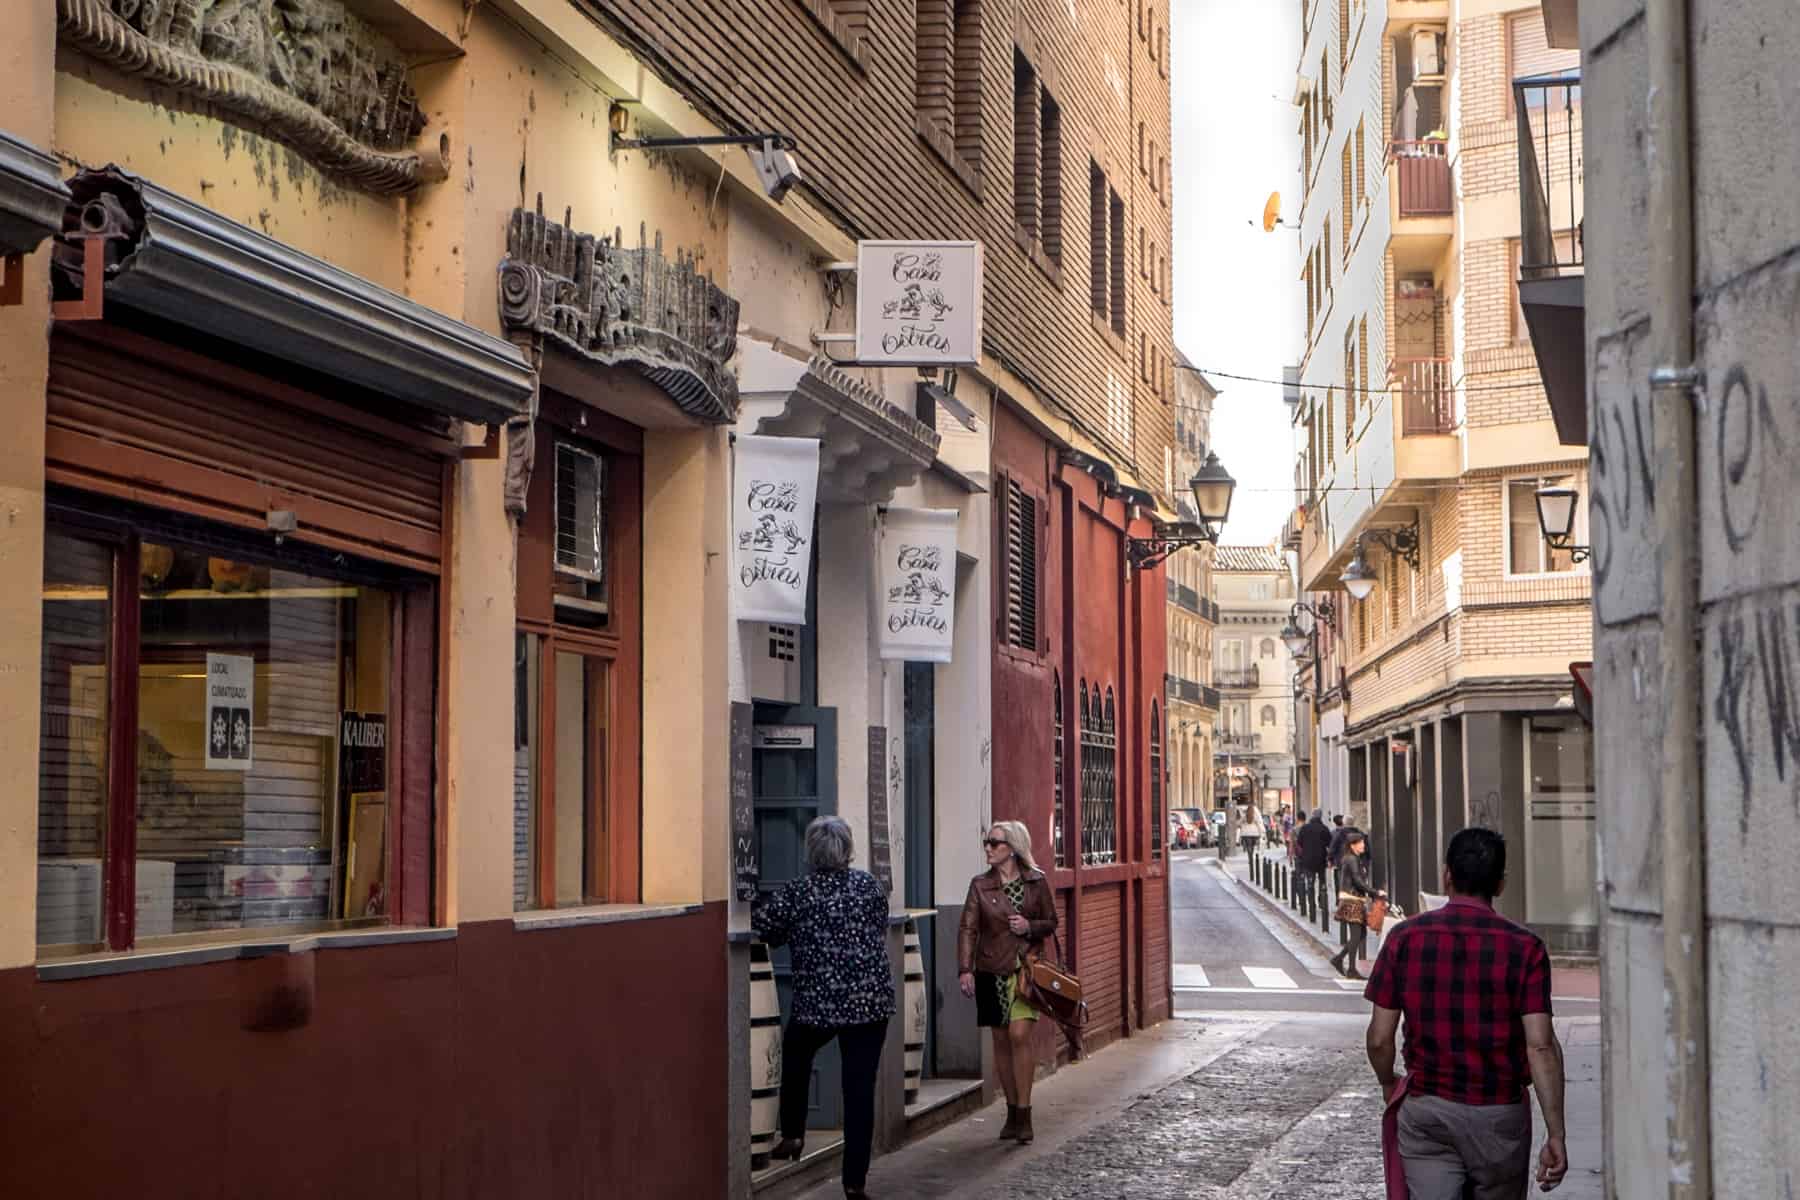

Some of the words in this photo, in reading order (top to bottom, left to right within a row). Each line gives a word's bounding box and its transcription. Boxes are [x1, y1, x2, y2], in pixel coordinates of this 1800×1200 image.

[892, 251, 942, 283] Casa
[747, 480, 797, 512] Casa
[897, 545, 941, 571] Casa
[343, 720, 385, 748] KALIBER
